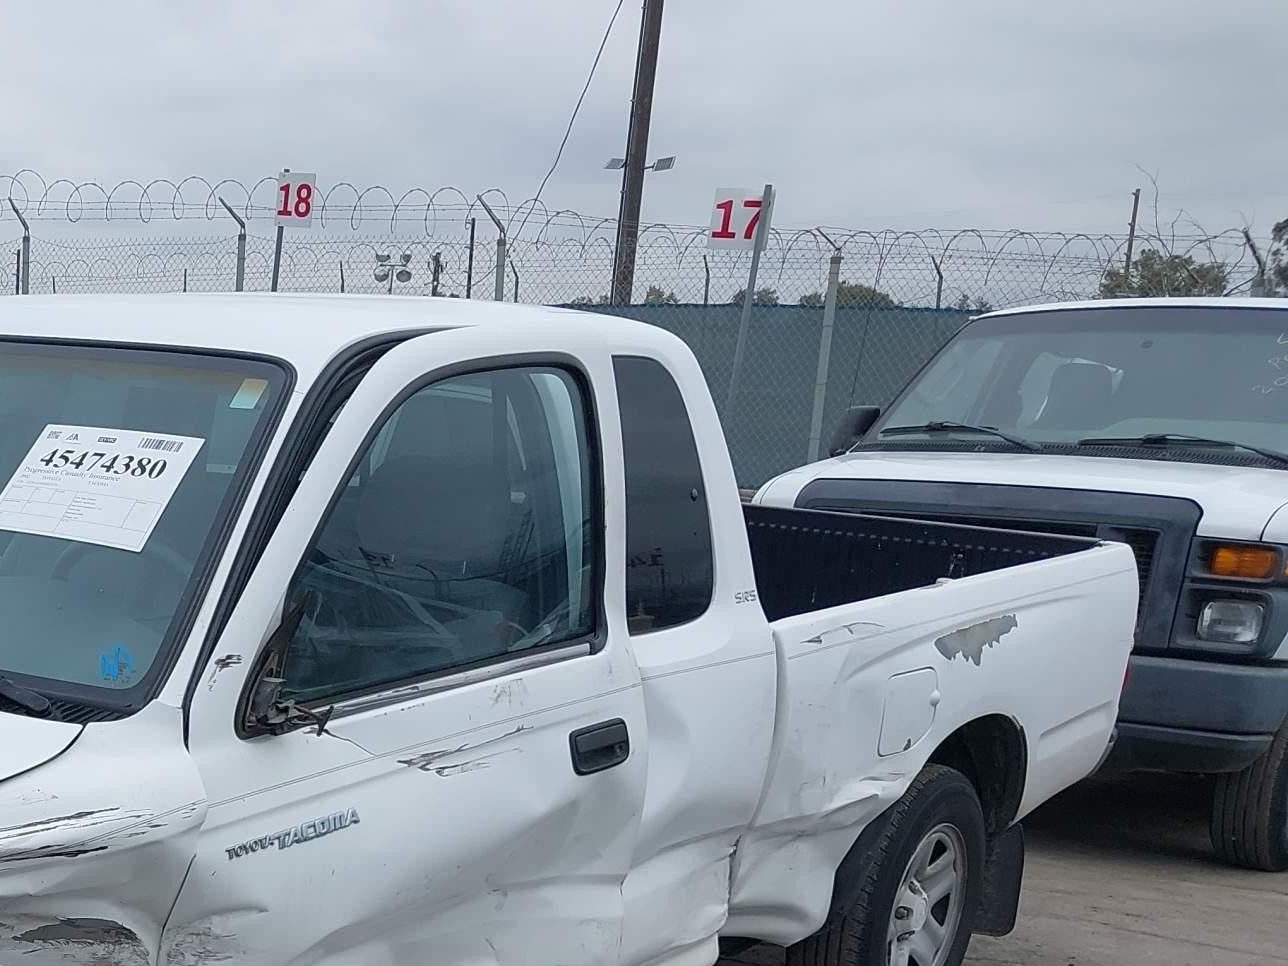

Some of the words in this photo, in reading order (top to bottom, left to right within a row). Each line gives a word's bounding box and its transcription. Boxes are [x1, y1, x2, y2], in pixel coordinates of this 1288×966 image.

[277, 183, 312, 218] 18
[711, 199, 762, 240] 17
[39, 448, 168, 480] 45474380
[273, 806, 361, 850] TACOMA
